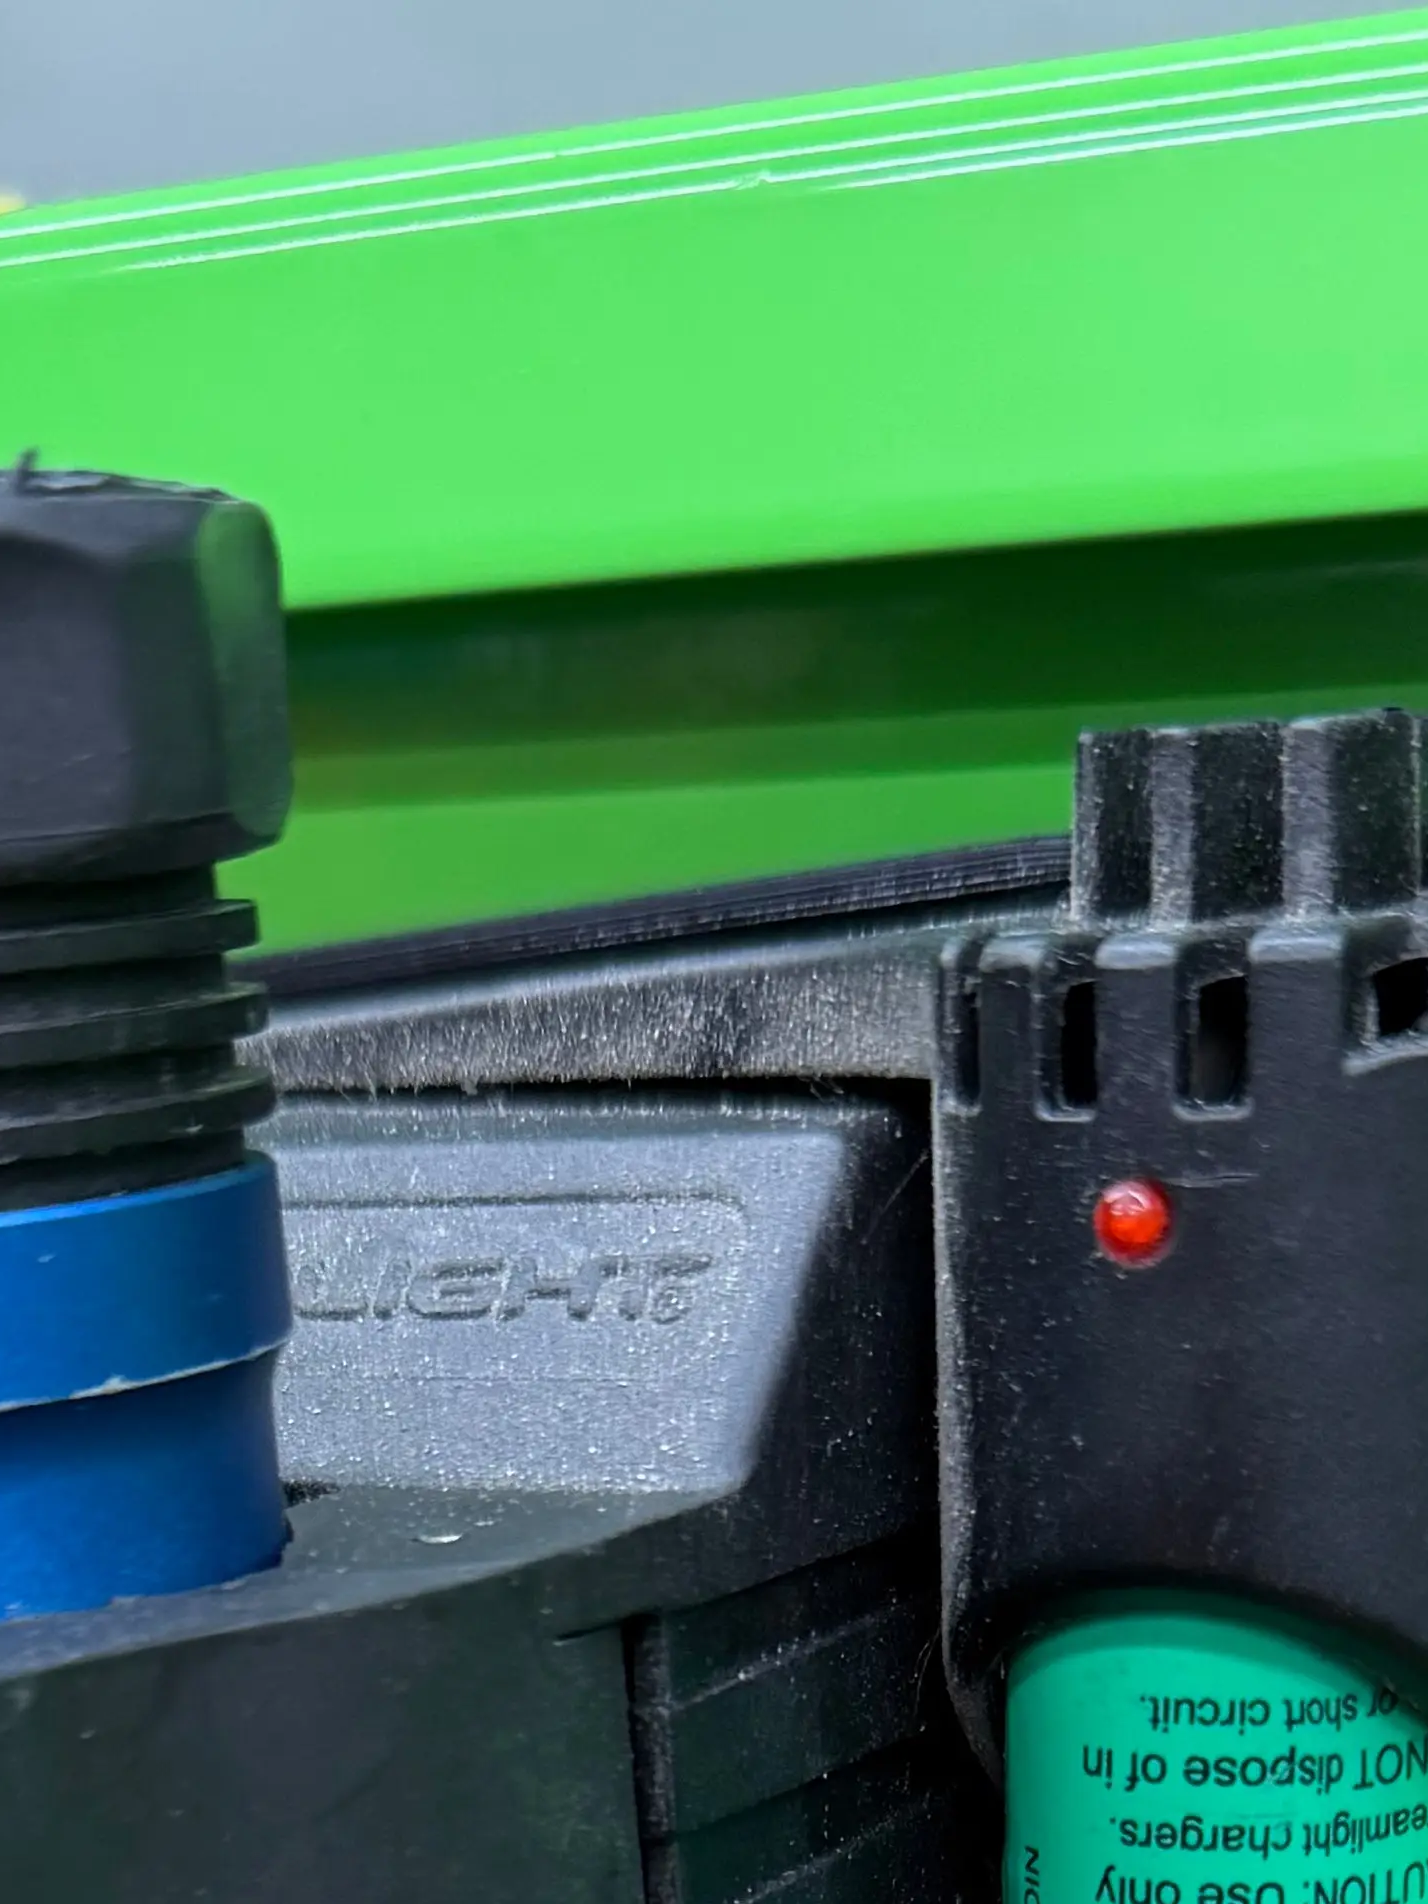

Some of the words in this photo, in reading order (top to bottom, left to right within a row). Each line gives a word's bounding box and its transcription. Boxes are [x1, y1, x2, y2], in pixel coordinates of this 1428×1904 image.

[1139, 1694, 1270, 1731] circuit.
[1284, 1694, 1359, 1732] short
[1082, 1744, 1114, 1789] in
[1128, 1745, 1167, 1792] of
[1184, 1744, 1344, 1795] dispose
[1110, 1813, 1291, 1862] chargers.
